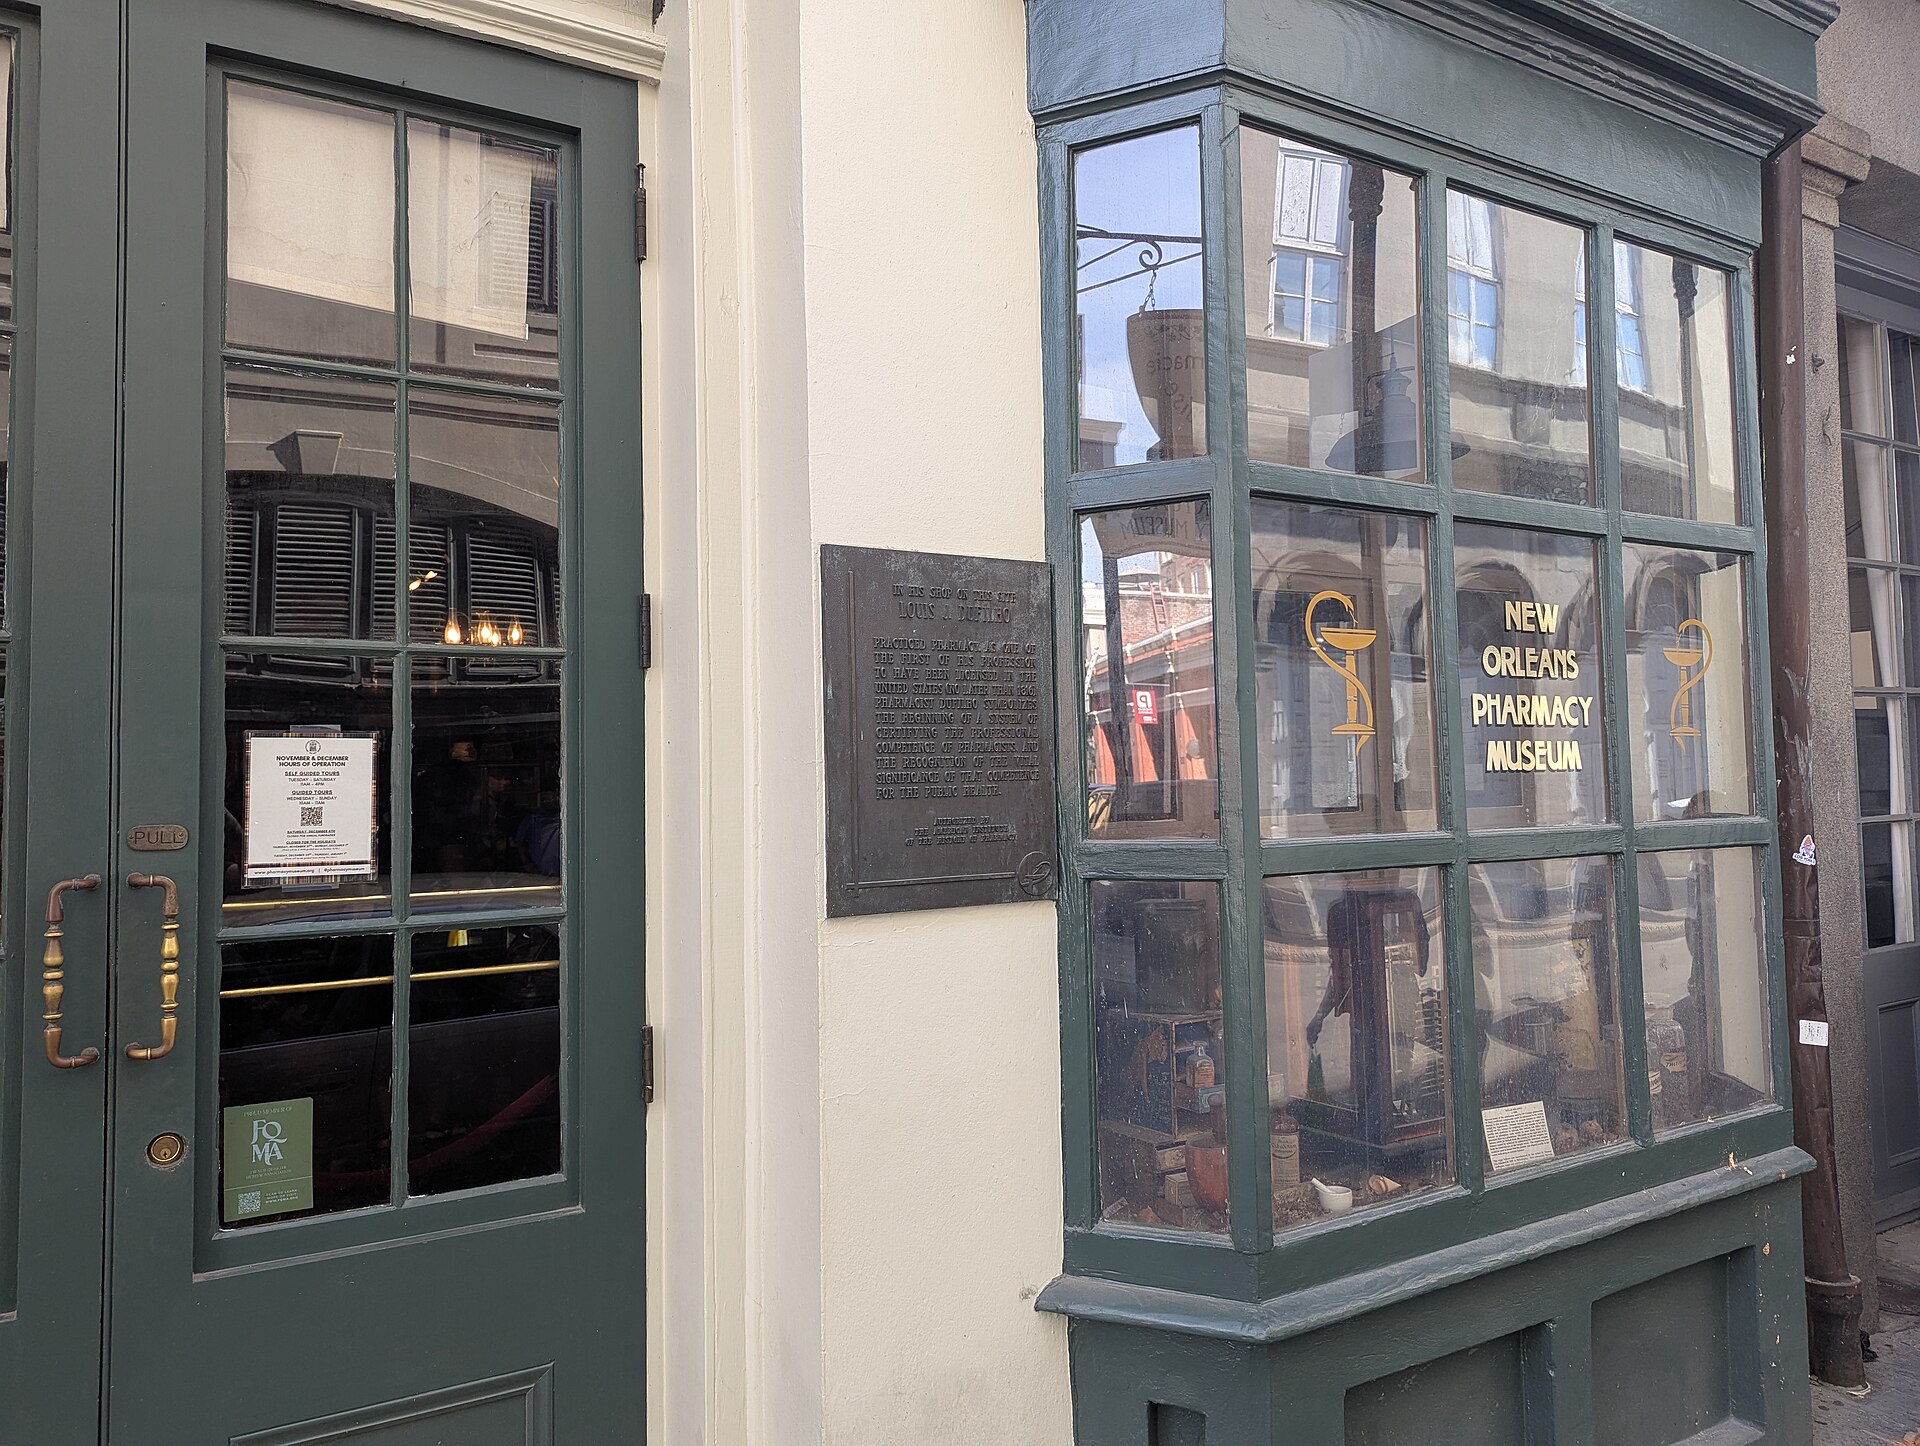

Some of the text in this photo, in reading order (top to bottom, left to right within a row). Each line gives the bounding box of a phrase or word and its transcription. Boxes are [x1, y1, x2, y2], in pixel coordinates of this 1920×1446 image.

[893, 583, 1017, 603] IN HIS SHOP ON THIS SITE
[899, 601, 1011, 623] LOUIS J. DUFILHO
[1504, 600, 1559, 634] NEW
[873, 637, 926, 650] PRACTICED
[984, 641, 996, 653] AS
[1002, 642, 1019, 654] ONE
[1026, 642, 1036, 655] OF
[873, 652, 1037, 669] THE FIRST OF HIS PROFESSION
[1482, 645, 1580, 680] ORLEANS
[875, 667, 1037, 683] TO HAVE BEEN LICENSED IN THE
[874, 682, 908, 694] UNITED
[912, 682, 943, 695] STATES
[945, 683, 960, 695] (NO
[962, 684, 989, 696] LATER
[992, 685, 1014, 697] THAN
[875, 697, 1038, 711] PHARMACIST DUFILHO SYMBOLIZES
[1471, 693, 1594, 728] PHARMACY
[875, 711, 1038, 725] THE BEGINNING OF A SYSTEM OF
[875, 727, 1039, 739] CERTIFYING THE PROFESSIONAL
[876, 741, 936, 754] COMPETENCE
[942, 741, 953, 753] OF
[1022, 741, 1039, 752] AND
[876, 755, 1040, 768] THE RECOGNITION OF THE VITAL
[1486, 739, 1583, 773] MUSEUM
[876, 769, 1040, 784] SIGNIFICANCE OF THAT COMPETENCE
[876, 785, 1002, 799] FOR THE PUBLIC HEALTH.
[933, 816, 976, 826] AUTHORIZED
[134, 830, 184, 844] PULL
[914, 824, 1008, 836] THE AMERICAN INSTITUTE
[905, 837, 914, 846] OF
[918, 837, 932, 845] THE
[936, 836, 966, 844] HISTORY
[970, 835, 978, 843] OF
[252, 1142, 284, 1166] MA
